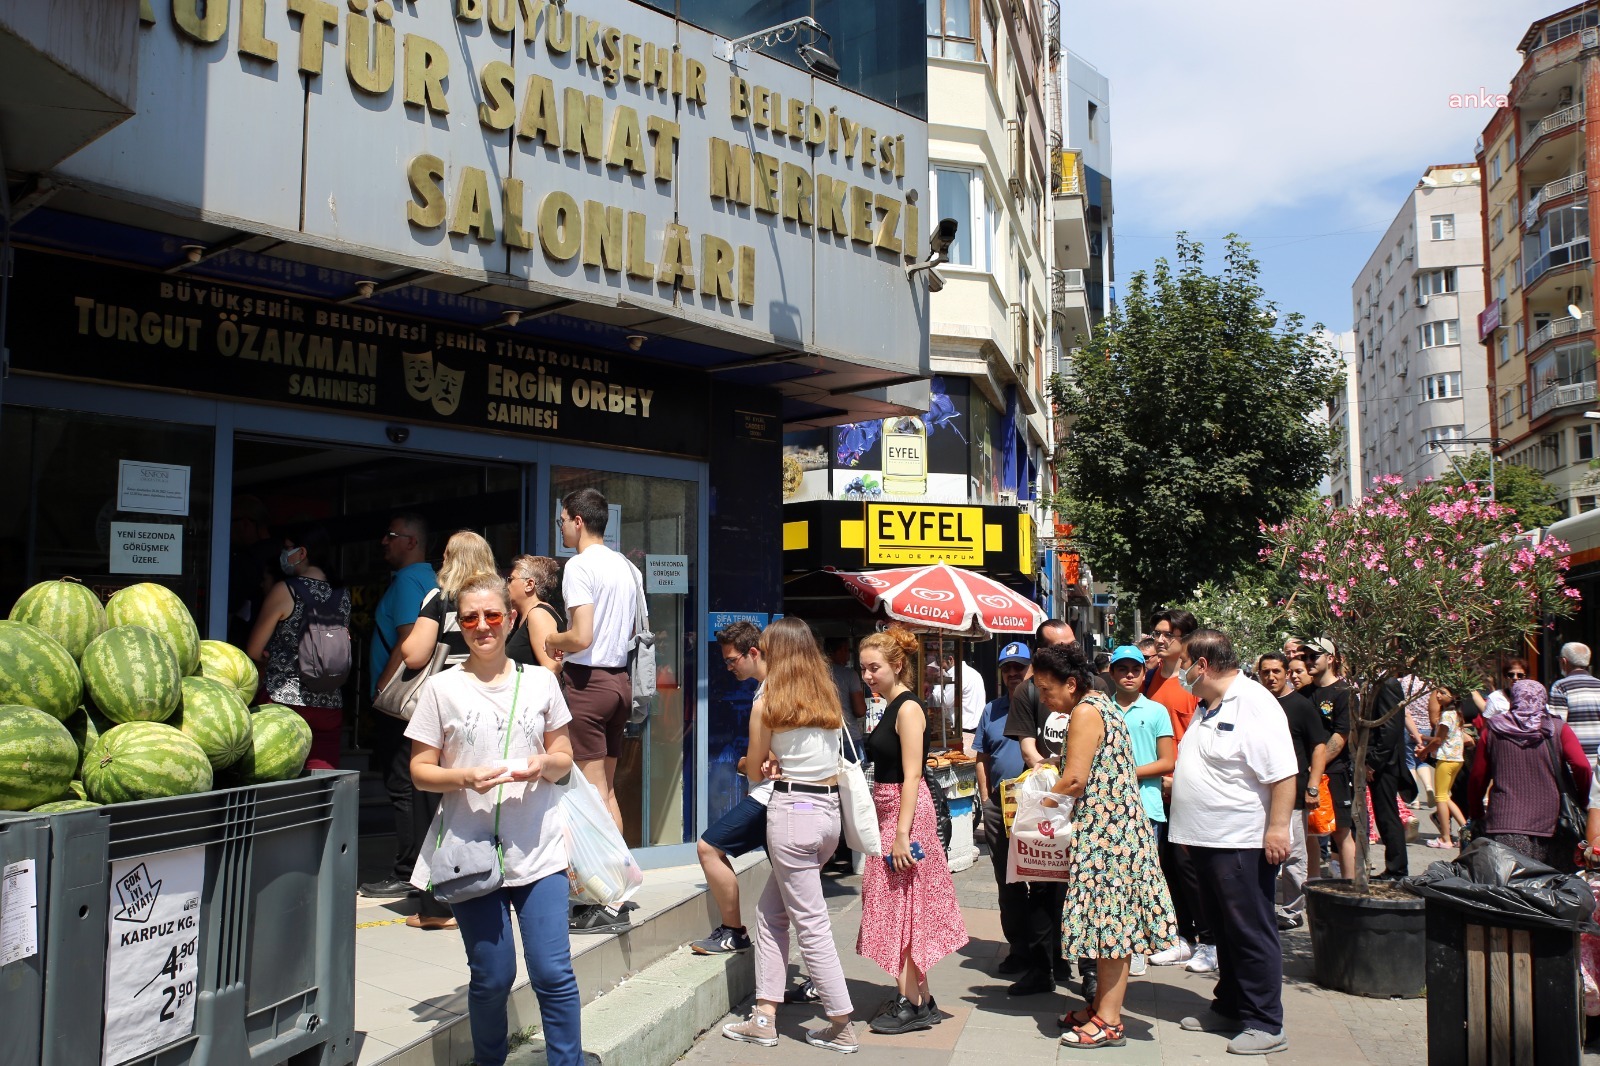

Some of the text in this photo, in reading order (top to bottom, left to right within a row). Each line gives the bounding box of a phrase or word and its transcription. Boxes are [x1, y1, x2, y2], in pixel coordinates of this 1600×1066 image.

[729, 75, 905, 178] BELEDİYESİ
[479, 60, 680, 182] SANAT
[709, 137, 919, 258] MERKEZİ
[407, 153, 755, 306] SALONLARI
[74, 296, 378, 377] TURGUT ÖZAKMAN
[160, 281, 609, 374] BÜYÜKŞEHİR BELEDİYESİ ŞEHİR TİYATROLARI
[288, 374, 376, 405] SAHNESİ
[487, 364, 654, 418] ERGİN ORBEY
[487, 402, 558, 430] SAHNESİ
[888, 446, 920, 459] EYFEL
[117, 530, 175, 540] YENİ SEZONDA
[878, 510, 973, 542] EYFEL
[123, 543, 169, 552] GÖRÜŞMEK
[733, 615, 761, 623] TERMAL
[1023, 858, 1046, 867] KUMAŞ
[123, 871, 142, 891] ÇOK
[130, 884, 144, 901] İYİ
[120, 916, 196, 947] KARPUZ KG.
